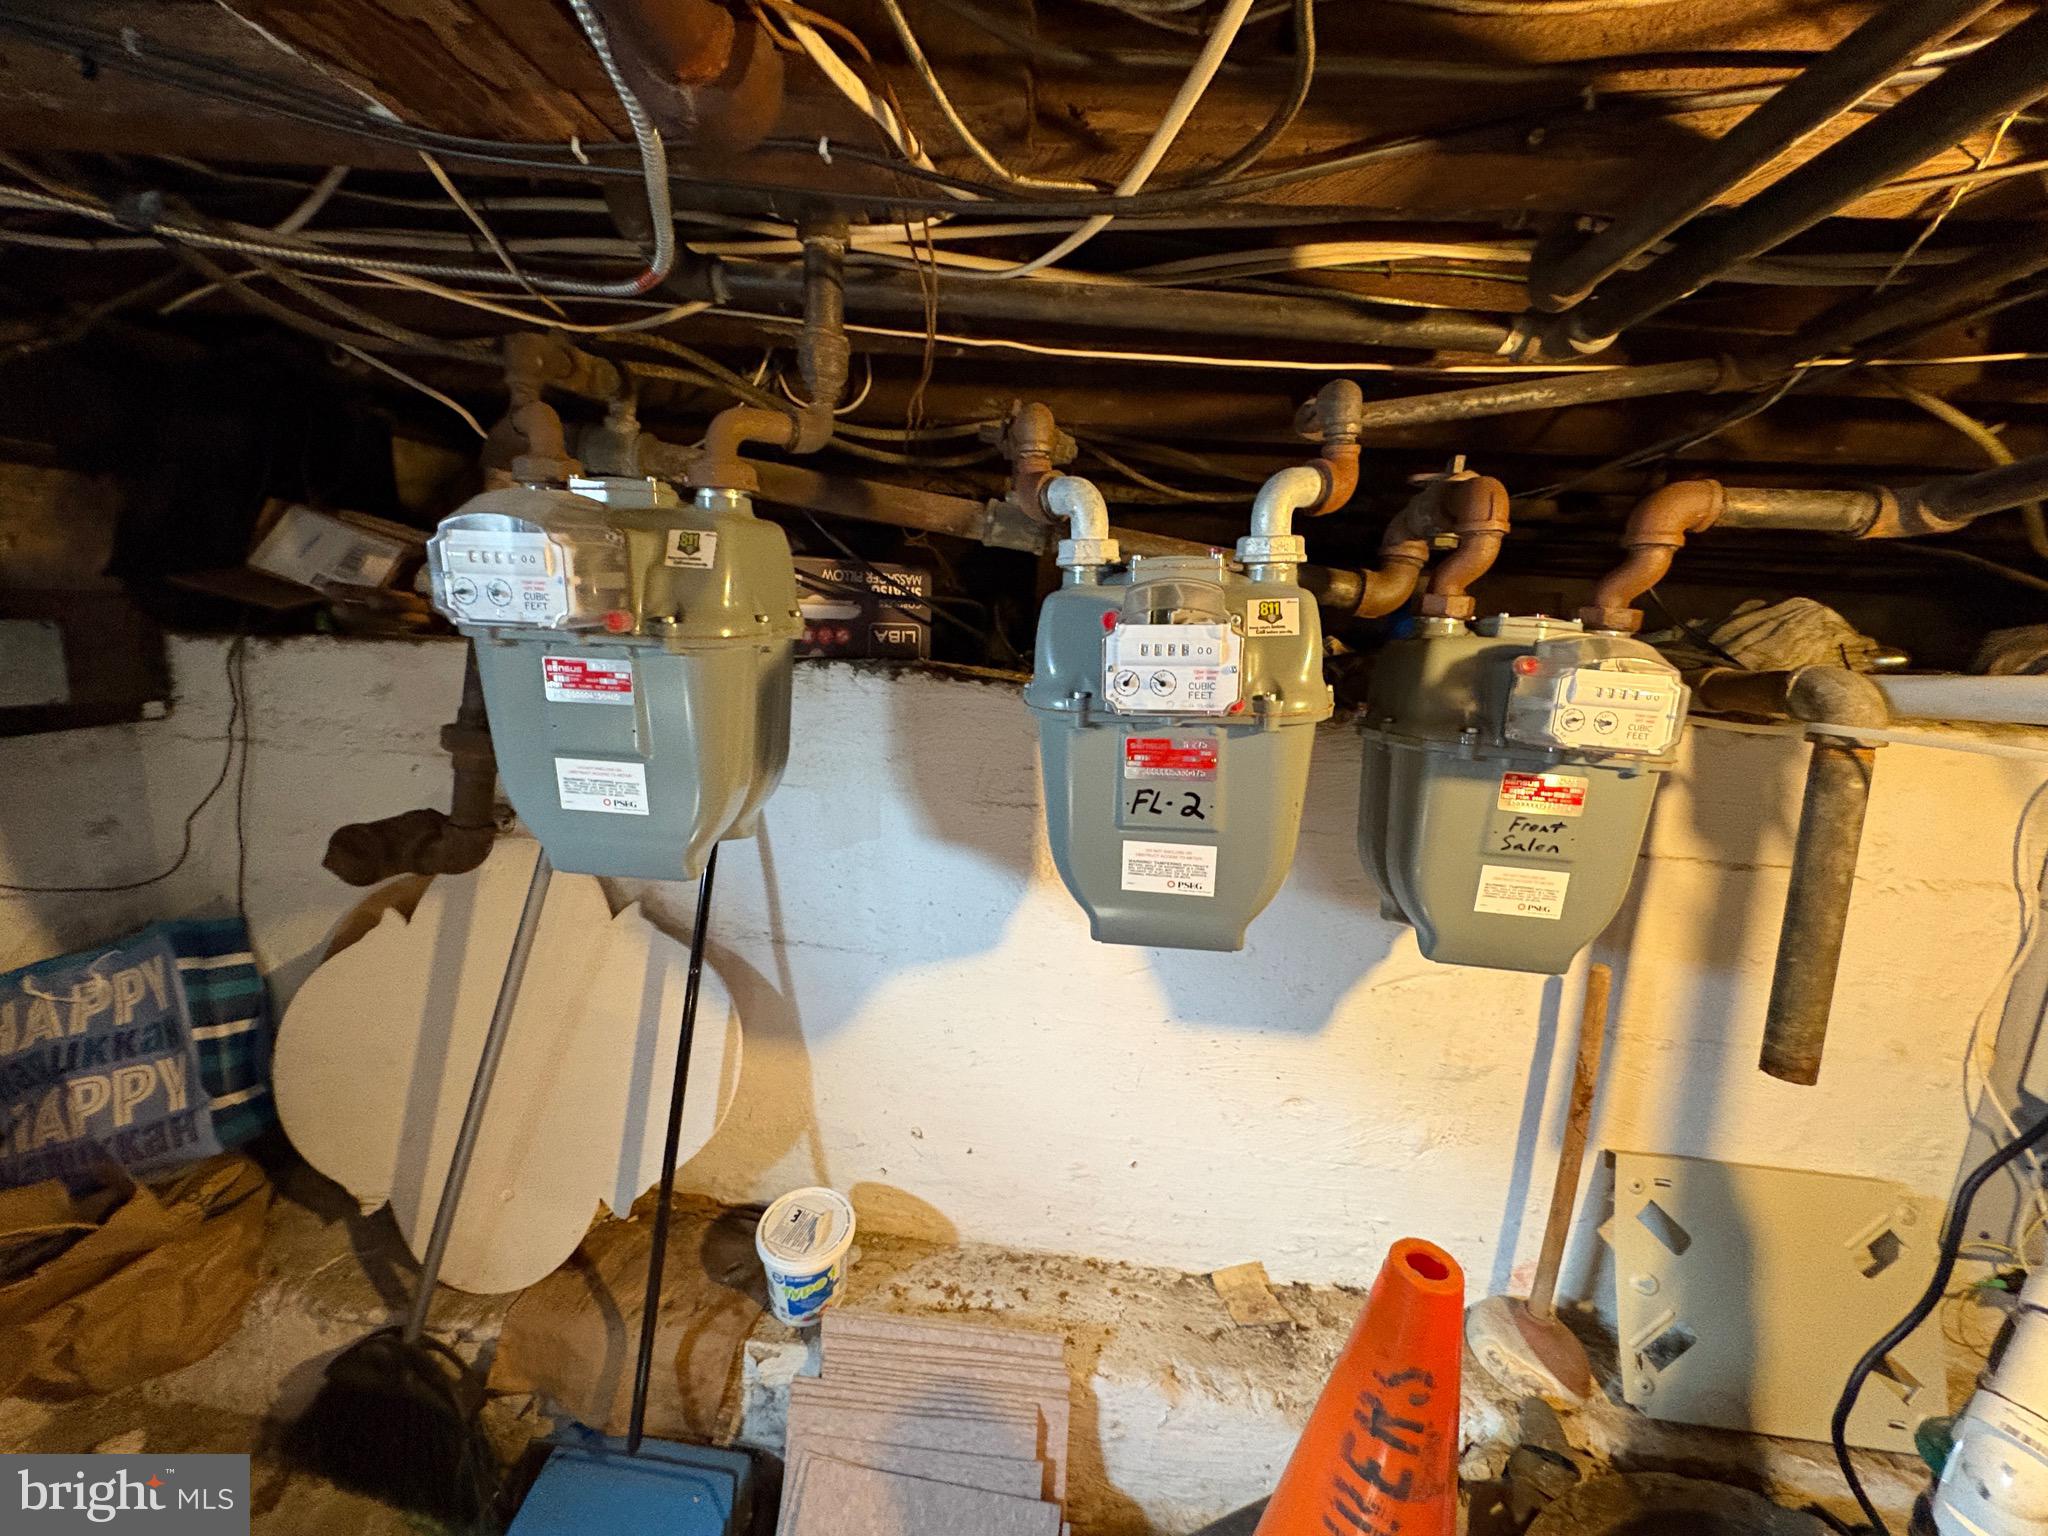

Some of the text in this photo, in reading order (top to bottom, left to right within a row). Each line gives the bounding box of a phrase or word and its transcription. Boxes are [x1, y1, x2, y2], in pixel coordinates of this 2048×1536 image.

[680, 531, 700, 547] 811
[865, 570, 922, 586] MASSER
[523, 591, 551, 602] CUBIC
[524, 601, 548, 611] FEET
[1260, 602, 1280, 617] 811
[874, 629, 917, 644] LIBA
[1188, 681, 1216, 691] CUBIC
[1188, 691, 1213, 700] FEET
[1627, 723, 1654, 733] CUBIC
[1626, 732, 1649, 741] FEET
[1508, 816, 1568, 834] Front
[1500, 834, 1560, 854] Salon
[1177, 881, 1203, 891] PSEG
